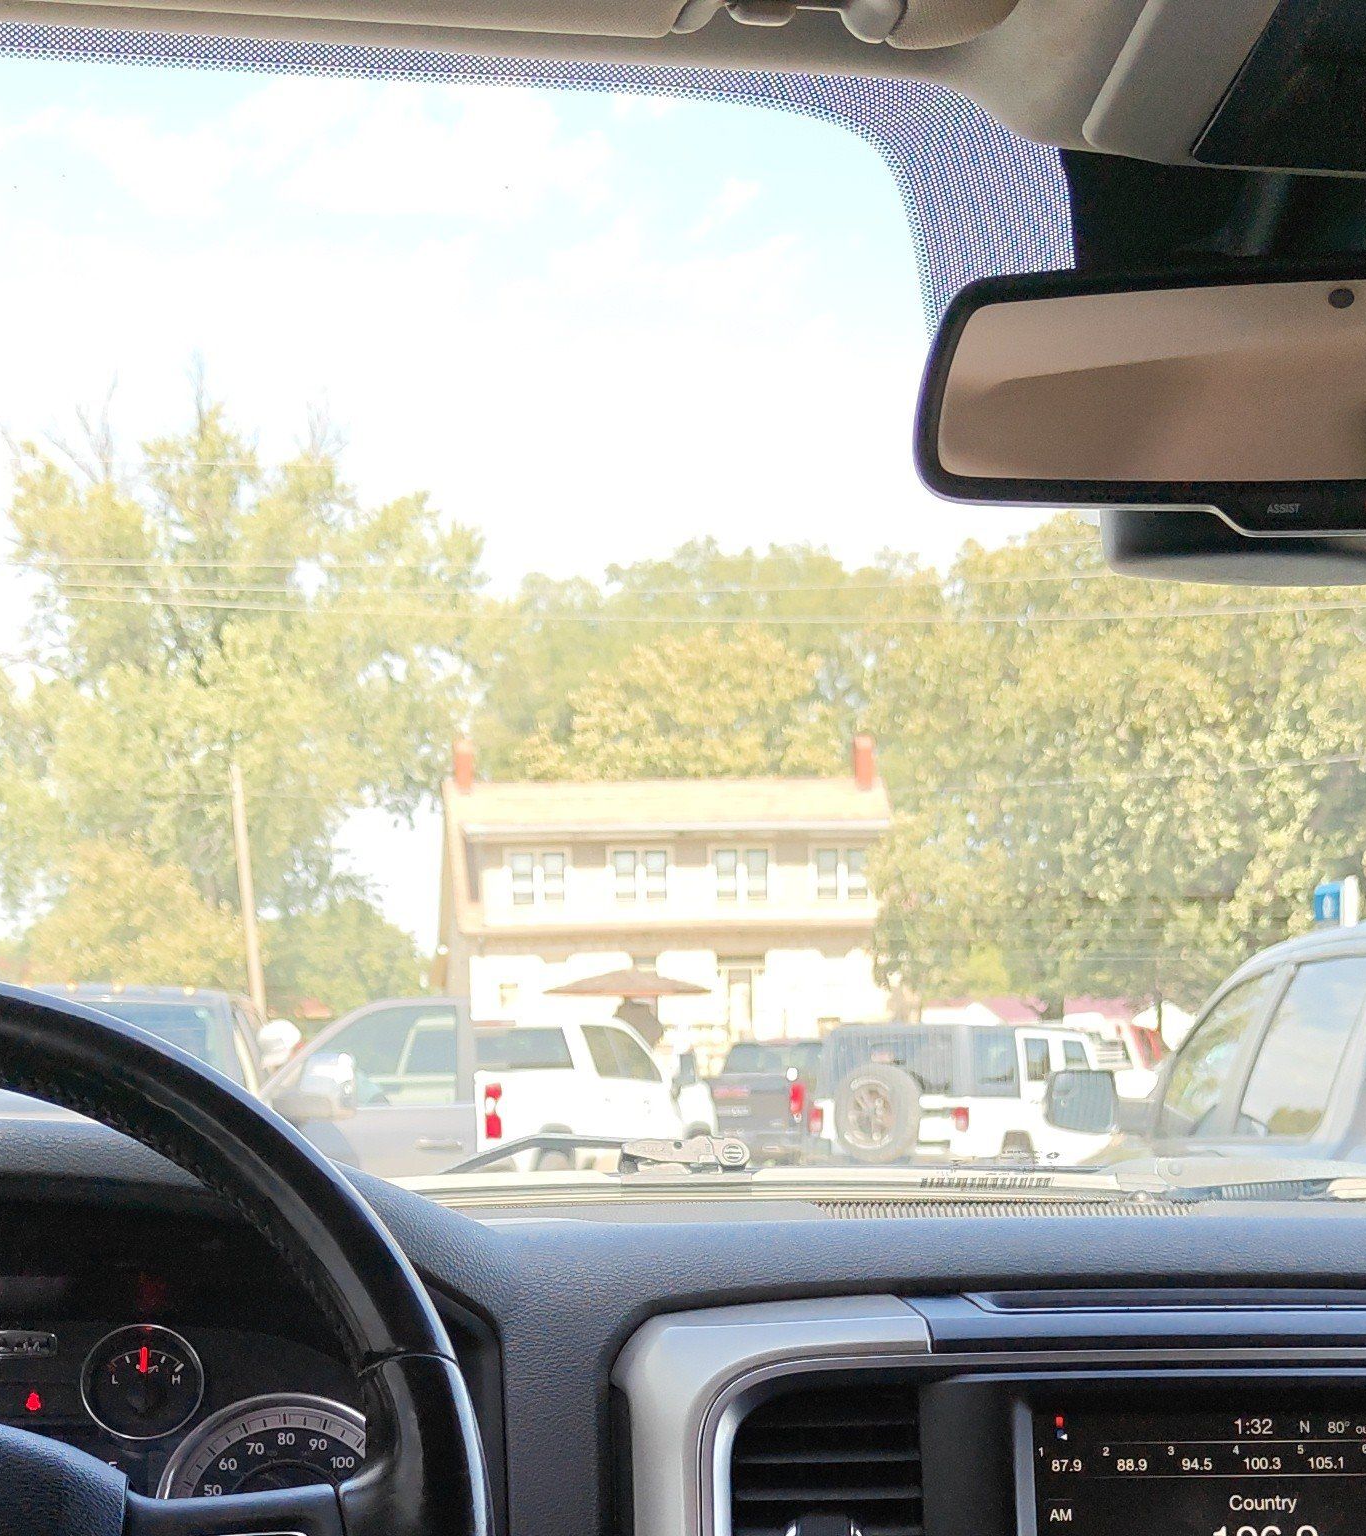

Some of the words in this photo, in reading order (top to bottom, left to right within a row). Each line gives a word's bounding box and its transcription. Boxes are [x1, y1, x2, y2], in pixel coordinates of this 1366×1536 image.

[1267, 503, 1300, 513] ASSIST
[1234, 1419, 1274, 1435] 1:32
[1299, 1421, 1311, 1434] N
[276, 1433, 296, 1446] 80
[308, 1439, 329, 1451] 90
[246, 1442, 266, 1456] 70
[1038, 1446, 1044, 1458] 1
[1102, 1446, 1111, 1457] 2
[1167, 1445, 1176, 1456] 3
[1232, 1445, 1241, 1455] 4
[1296, 1444, 1305, 1455] 5
[219, 1458, 239, 1471] 60
[330, 1456, 356, 1470] 100
[1051, 1459, 1083, 1473] 87.9
[1116, 1459, 1149, 1472] 88.9
[1181, 1458, 1214, 1472] 94.5
[1243, 1457, 1282, 1471] 100.3
[1307, 1456, 1345, 1470] 105.1
[204, 1484, 223, 1498] 50
[1228, 1494, 1298, 1514] Country
[1049, 1508, 1073, 1522] AM
